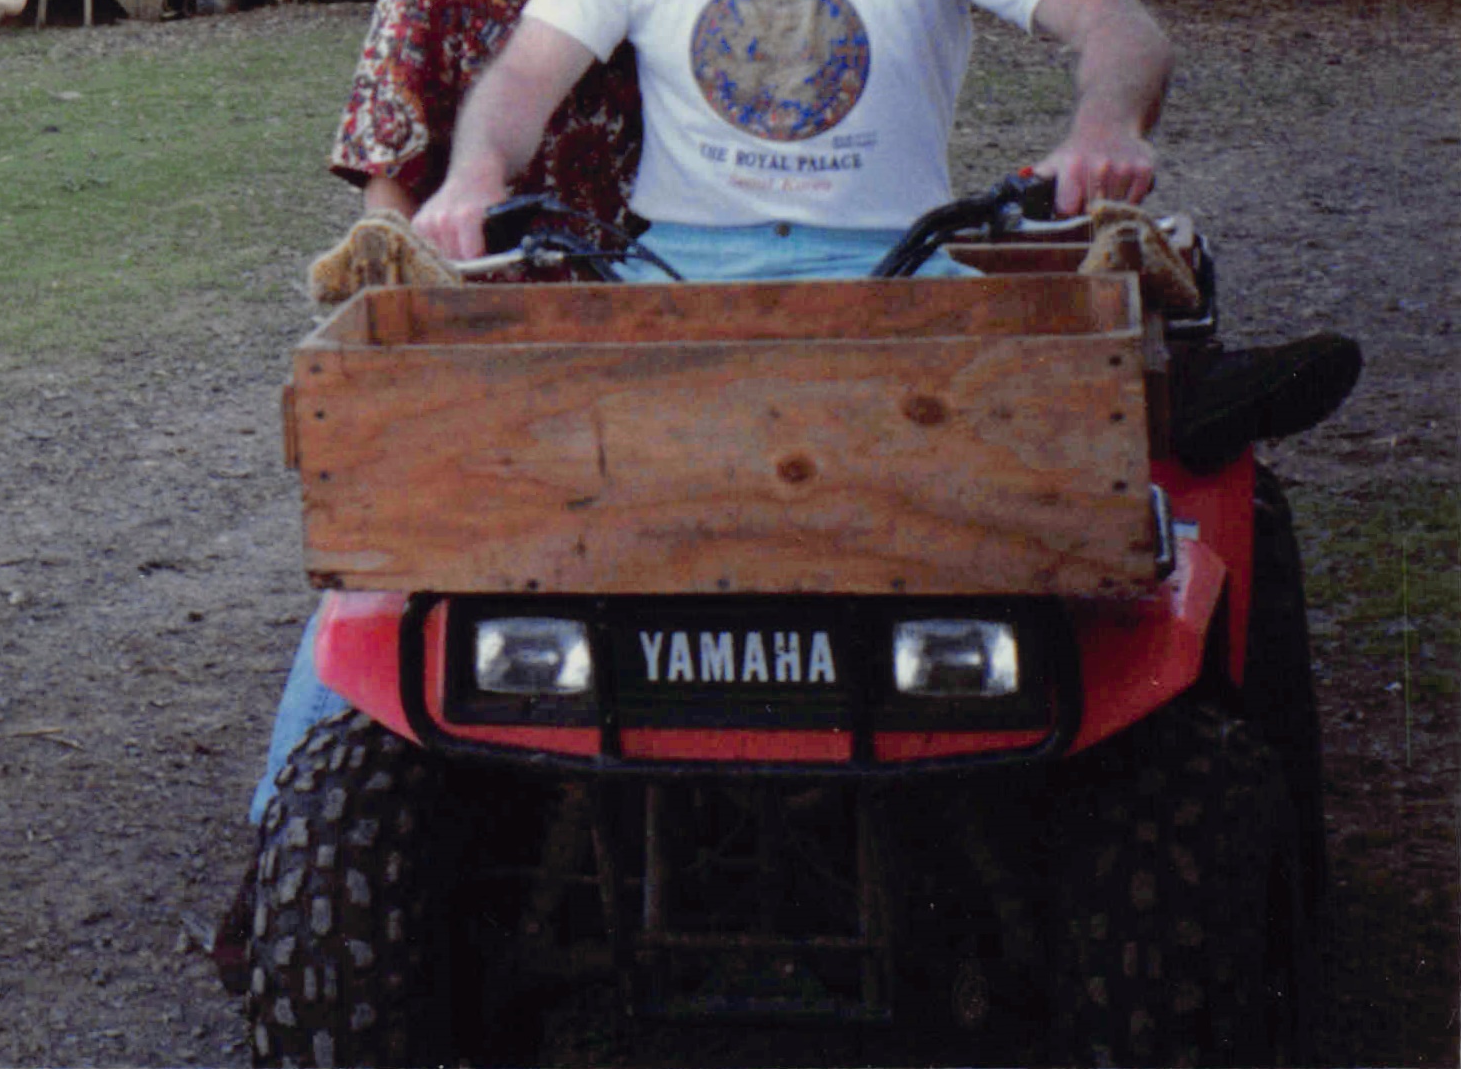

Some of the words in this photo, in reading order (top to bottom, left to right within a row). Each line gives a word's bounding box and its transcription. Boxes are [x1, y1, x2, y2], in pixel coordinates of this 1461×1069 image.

[736, 150, 789, 171] ROYAL
[796, 152, 862, 172] PALACE
[639, 630, 837, 682] YAMAHA
